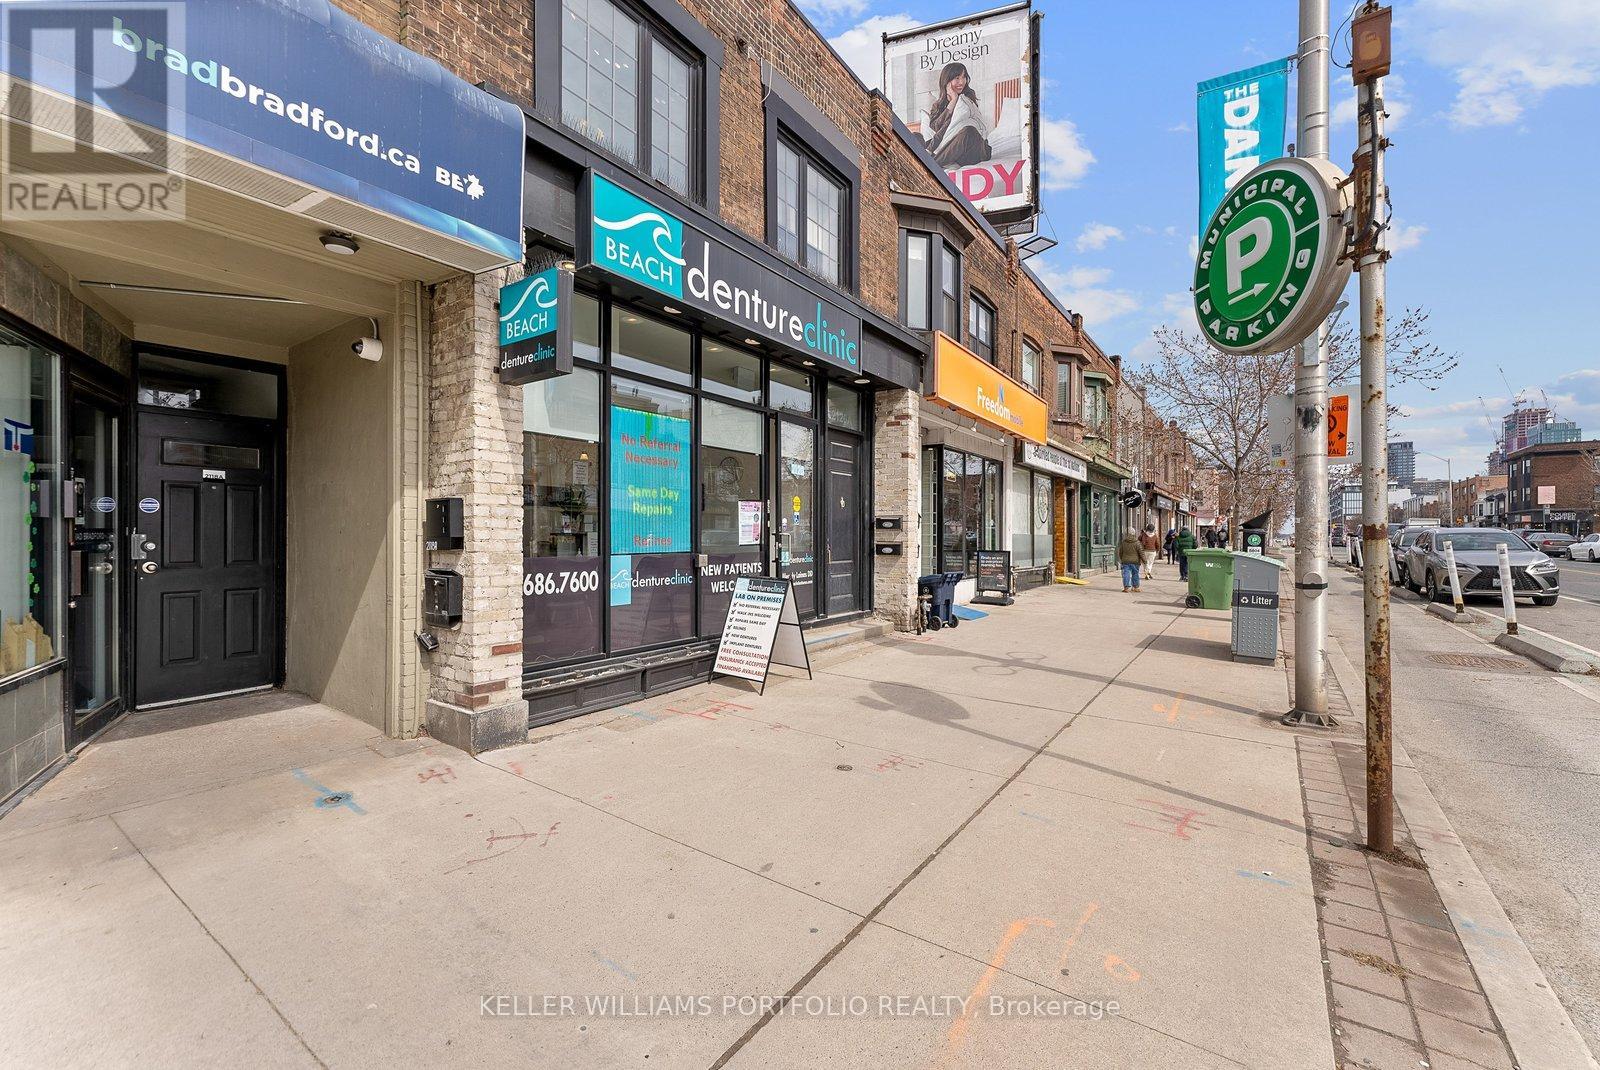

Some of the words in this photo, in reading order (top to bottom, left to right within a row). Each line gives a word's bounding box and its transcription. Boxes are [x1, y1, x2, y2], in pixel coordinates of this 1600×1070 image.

[926, 29, 983, 52] Dreamy
[920, 53, 937, 70] By
[941, 43, 989, 64] Design
[112, 16, 421, 175] bradbradford.ca
[1223, 81, 1260, 101] THE
[1200, 178, 1307, 270] MUNICIPAL
[1225, 216, 1272, 295] P
[606, 236, 673, 287] BEACH
[687, 241, 857, 366] dentureclinic
[1200, 248, 1311, 342] PARKING
[506, 311, 548, 339] BEACH
[501, 342, 556, 370] dentureclinic
[977, 386, 1011, 421] Freedom
[621, 433, 636, 446] No
[639, 435, 681, 452] Referral
[625, 451, 678, 469] Necessary
[627, 484, 658, 499] Same
[660, 486, 679, 502] Day
[632, 502, 672, 517] Repairs
[632, 569, 693, 588] dentureclinic
[701, 564, 721, 577] NEW
[724, 562, 762, 575] PATIENTS
[523, 570, 599, 596] 686.7600
[748, 580, 786, 593] dentureclinic
[756, 595, 782, 604] PREMISES
[1251, 595, 1273, 605] Litter
[721, 647, 732, 655] FREE
[716, 663, 742, 673] FINANCING
[718, 656, 744, 665] INSURANCE
[745, 658, 767, 669] ACCEPTED
